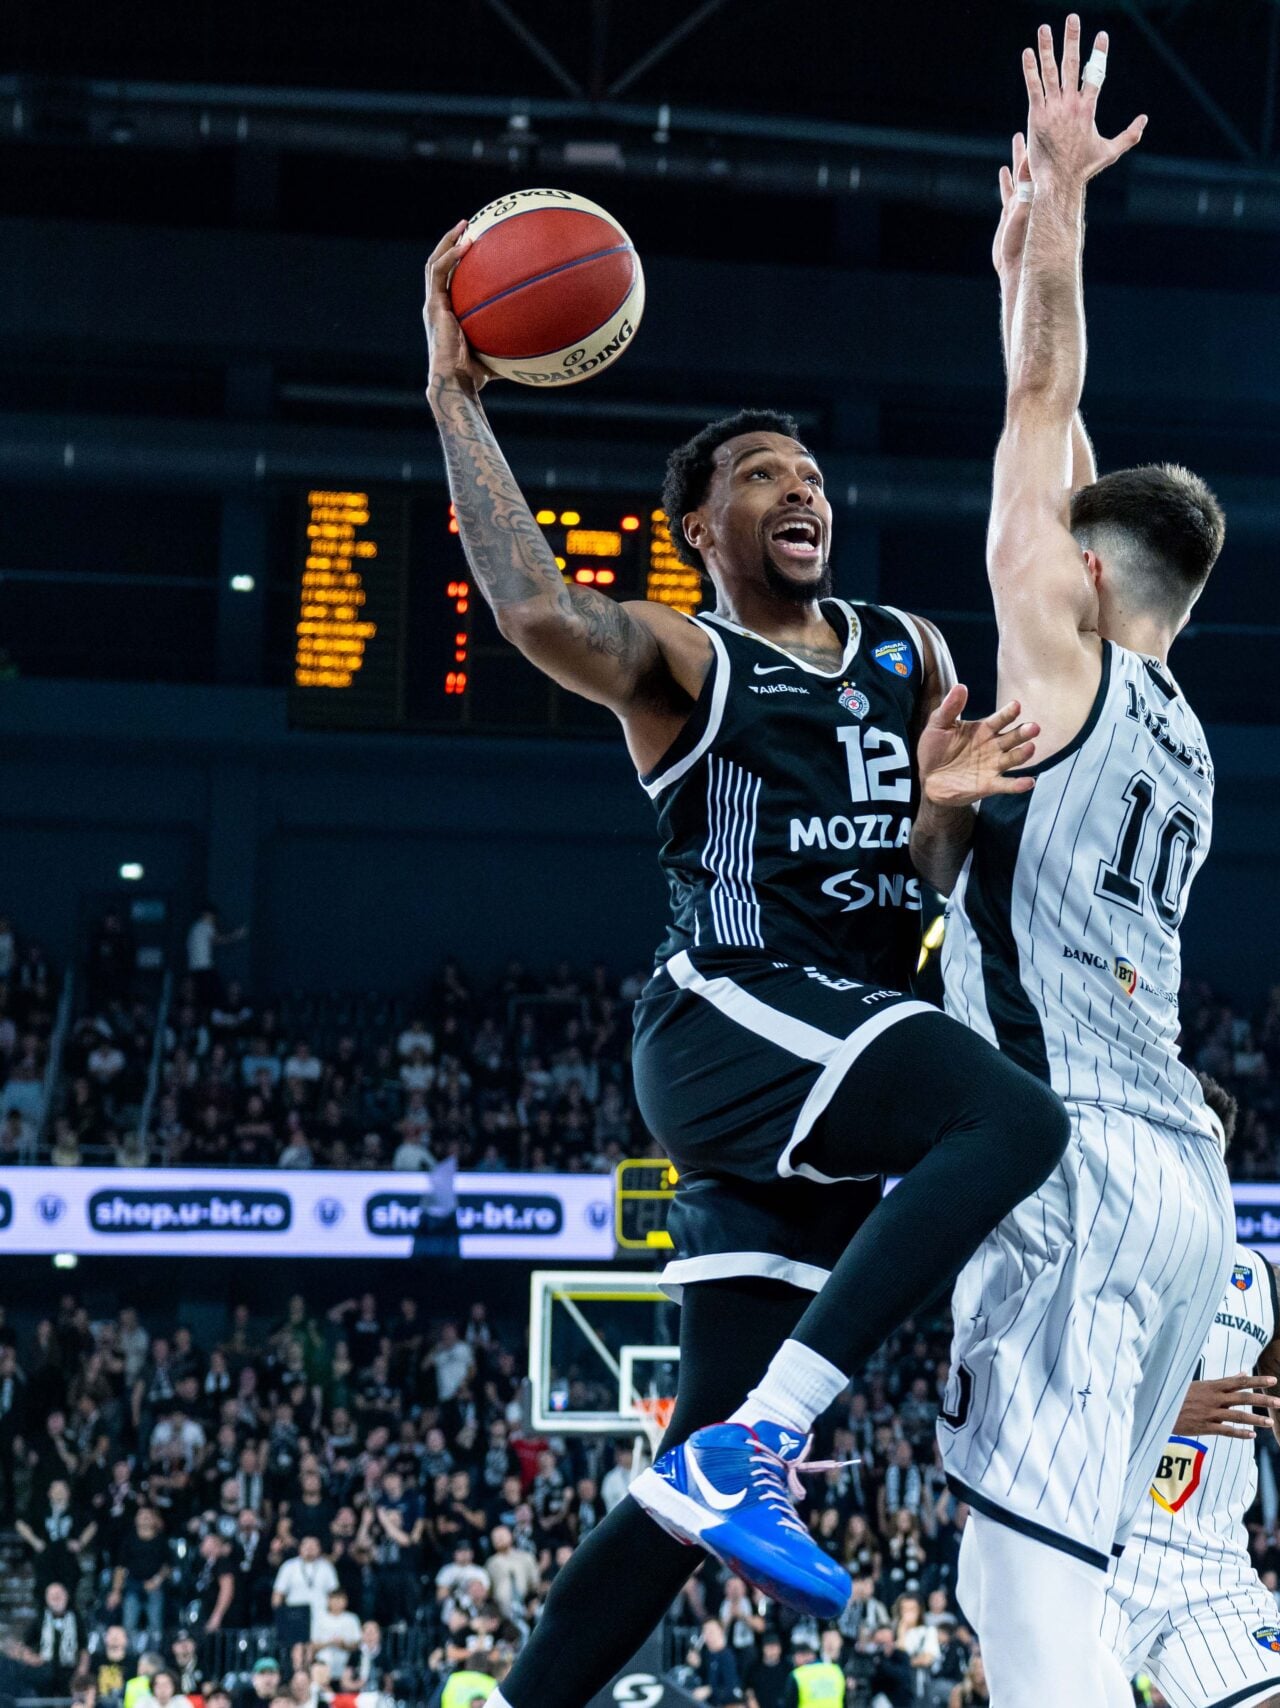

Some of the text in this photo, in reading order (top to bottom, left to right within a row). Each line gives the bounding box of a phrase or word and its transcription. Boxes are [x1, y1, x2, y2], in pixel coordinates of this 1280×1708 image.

[760, 684, 810, 694] AikBank
[836, 725, 912, 802] 12
[1093, 769, 1199, 938] 10
[1062, 945, 1111, 972] BANCA
[1118, 966, 1134, 983] BT
[95, 1197, 285, 1230] shop.u-bt.ro
[1155, 1455, 1192, 1481] BT
